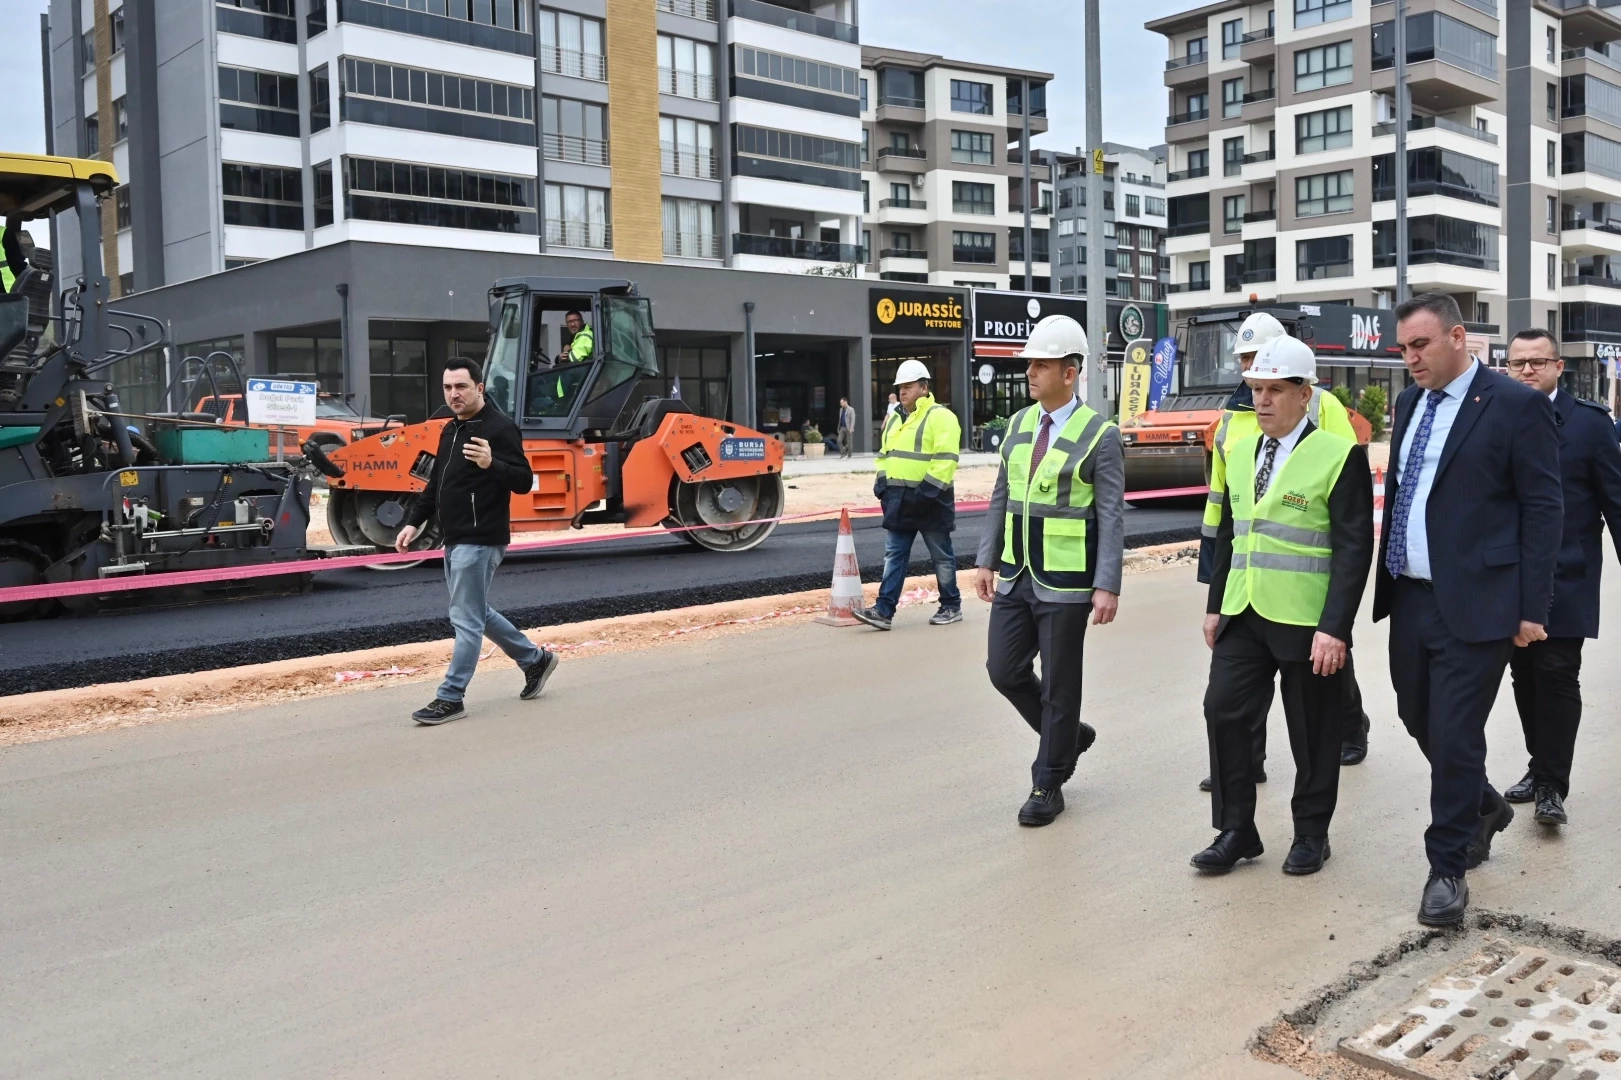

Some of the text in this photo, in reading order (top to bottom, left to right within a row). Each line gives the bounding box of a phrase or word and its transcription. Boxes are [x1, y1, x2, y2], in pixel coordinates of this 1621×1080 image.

[925, 319, 962, 329] PETSTORE
[352, 460, 398, 471] HAMM
[1283, 494, 1310, 506] BOZBEY
